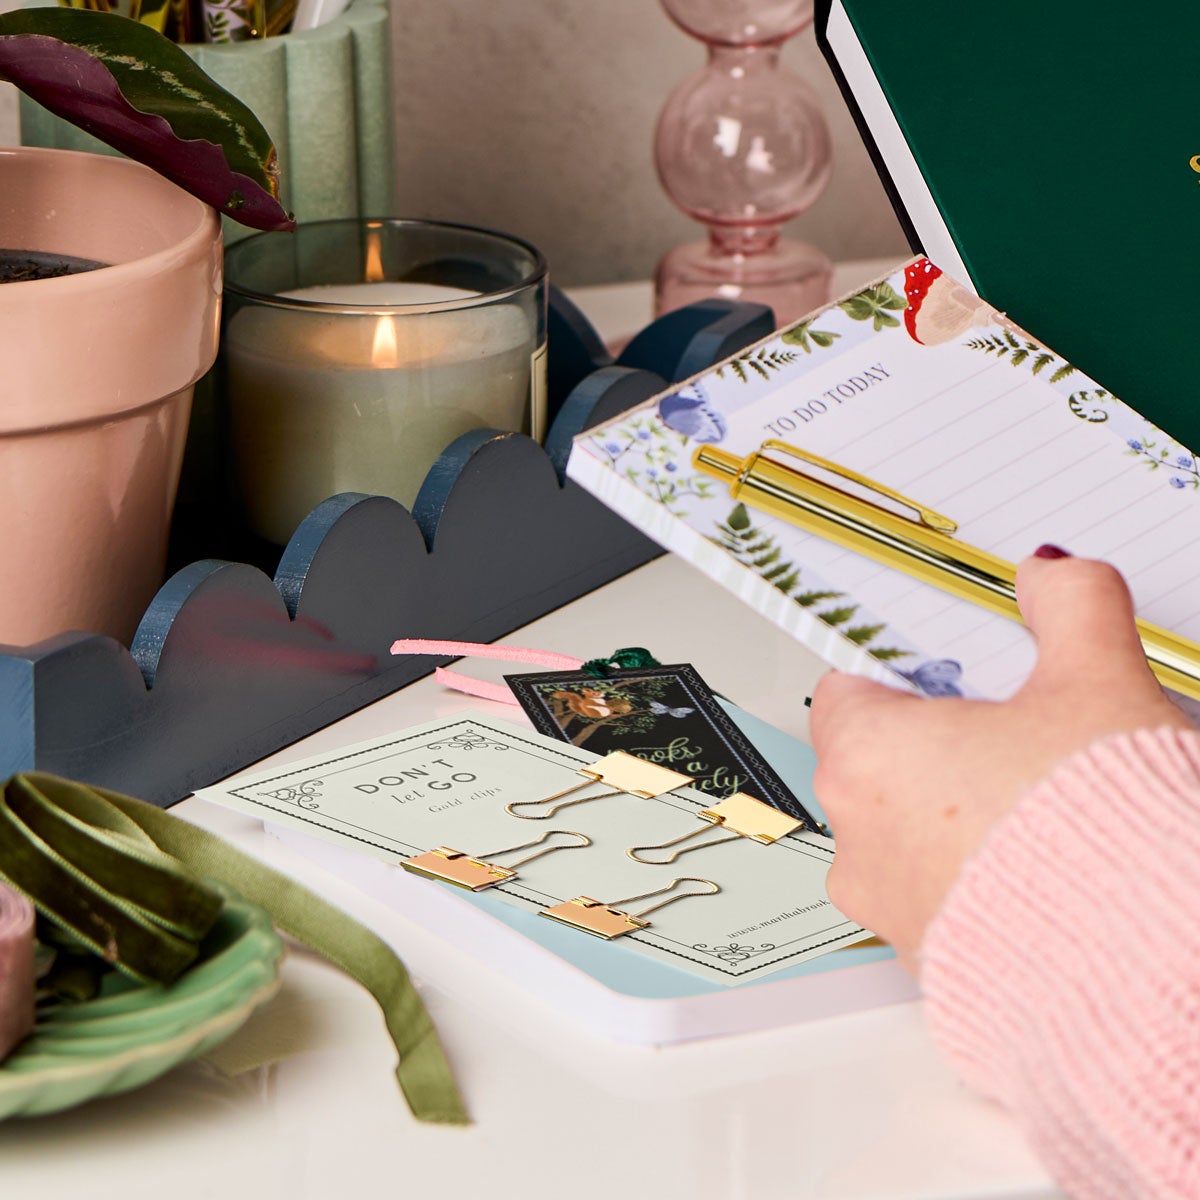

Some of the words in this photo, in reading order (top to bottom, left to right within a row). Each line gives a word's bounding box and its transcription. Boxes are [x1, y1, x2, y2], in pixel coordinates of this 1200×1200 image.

[764, 416, 797, 437] TO
[793, 399, 828, 423] DO
[823, 362, 891, 404] TODAY
[607, 736, 703, 763] ooks
[353, 758, 454, 794] DON'T
[391, 789, 426, 804] let
[427, 772, 477, 791] GO
[428, 798, 463, 813] Gold
[470, 786, 502, 801] clips
[727, 899, 831, 939] www.marthabrook
